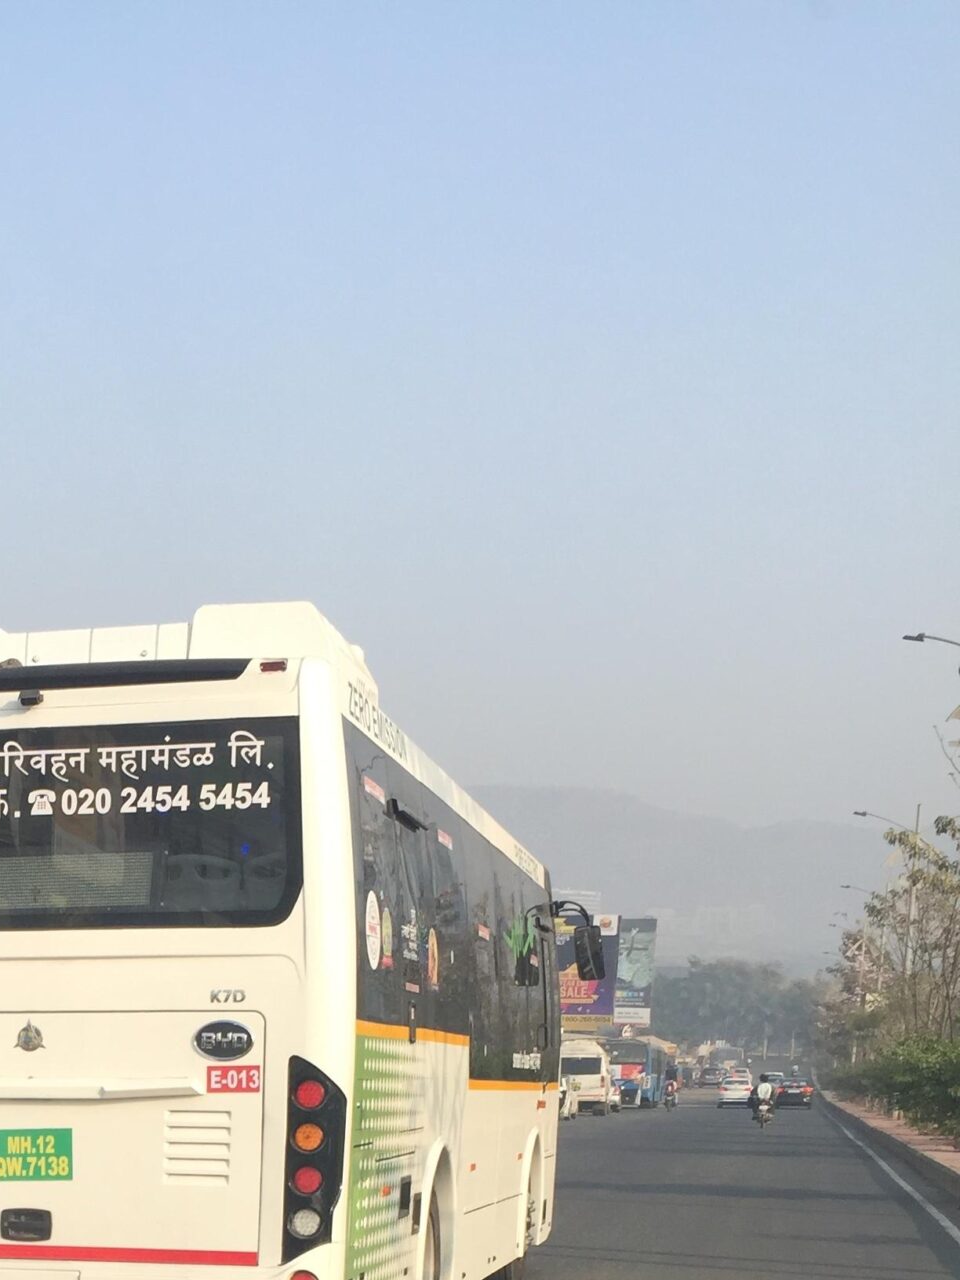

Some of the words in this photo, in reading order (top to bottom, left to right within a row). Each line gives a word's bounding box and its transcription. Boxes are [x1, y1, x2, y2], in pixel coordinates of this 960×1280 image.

[347, 681, 371, 732] ZERO
[97, 735, 216, 780] महामंडळ
[227, 730, 274, 770] लि.
[61, 788, 112, 815] 020
[120, 784, 190, 813] 2454
[199, 781, 271, 811] 5454
[210, 989, 246, 1003] K7D
[560, 986, 588, 997] SALE
[201, 1031, 248, 1049] BYD
[210, 1069, 259, 1089] E-013
[7, 1135, 55, 1154] MH.12
